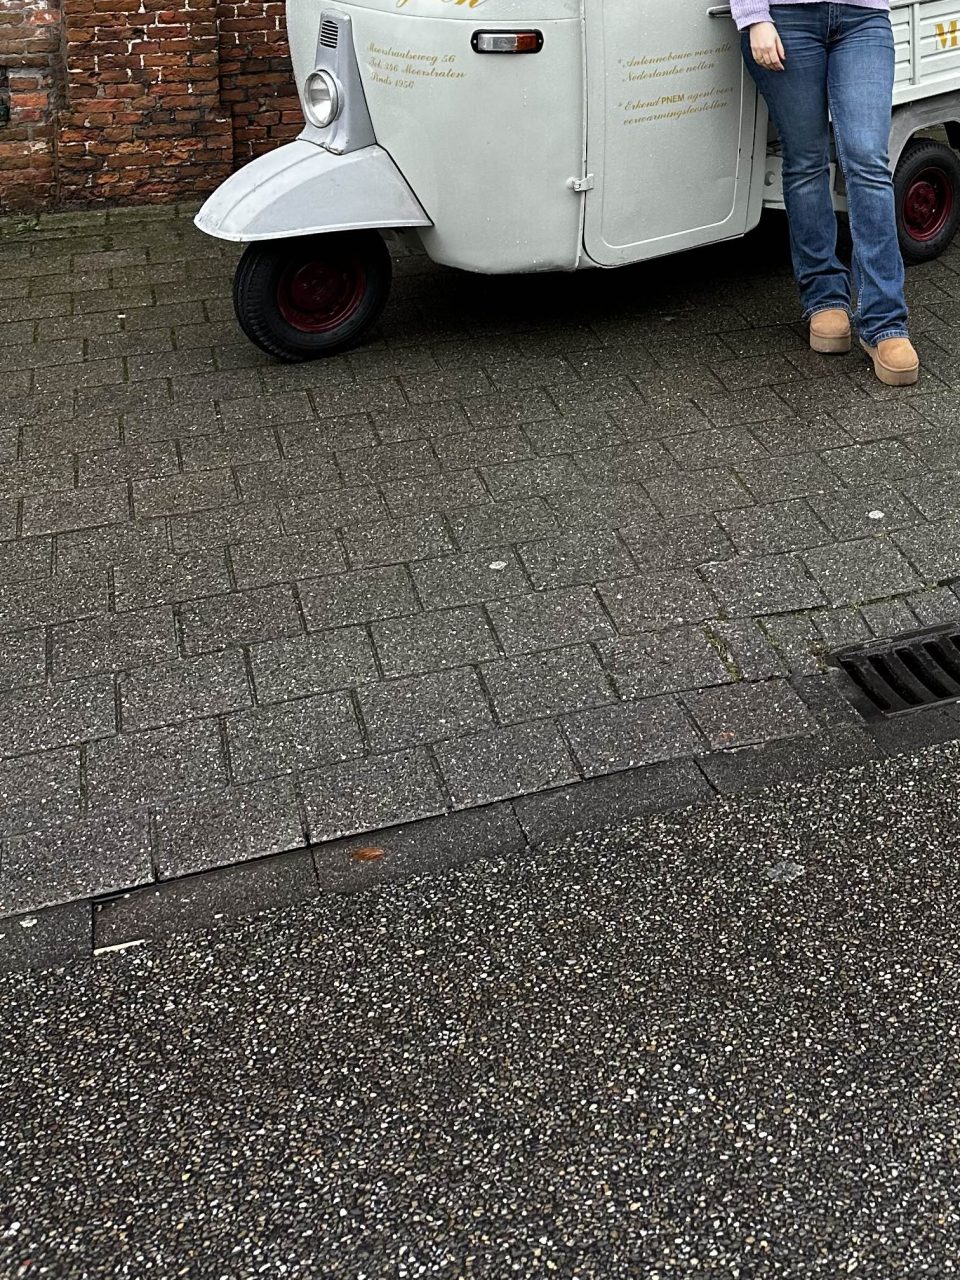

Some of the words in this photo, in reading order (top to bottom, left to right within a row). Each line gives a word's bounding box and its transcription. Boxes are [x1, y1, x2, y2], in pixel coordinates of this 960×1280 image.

[440, 54, 456, 63] 56
[624, 96, 661, 111] Erkend
[661, 93, 685, 105] PNEM
